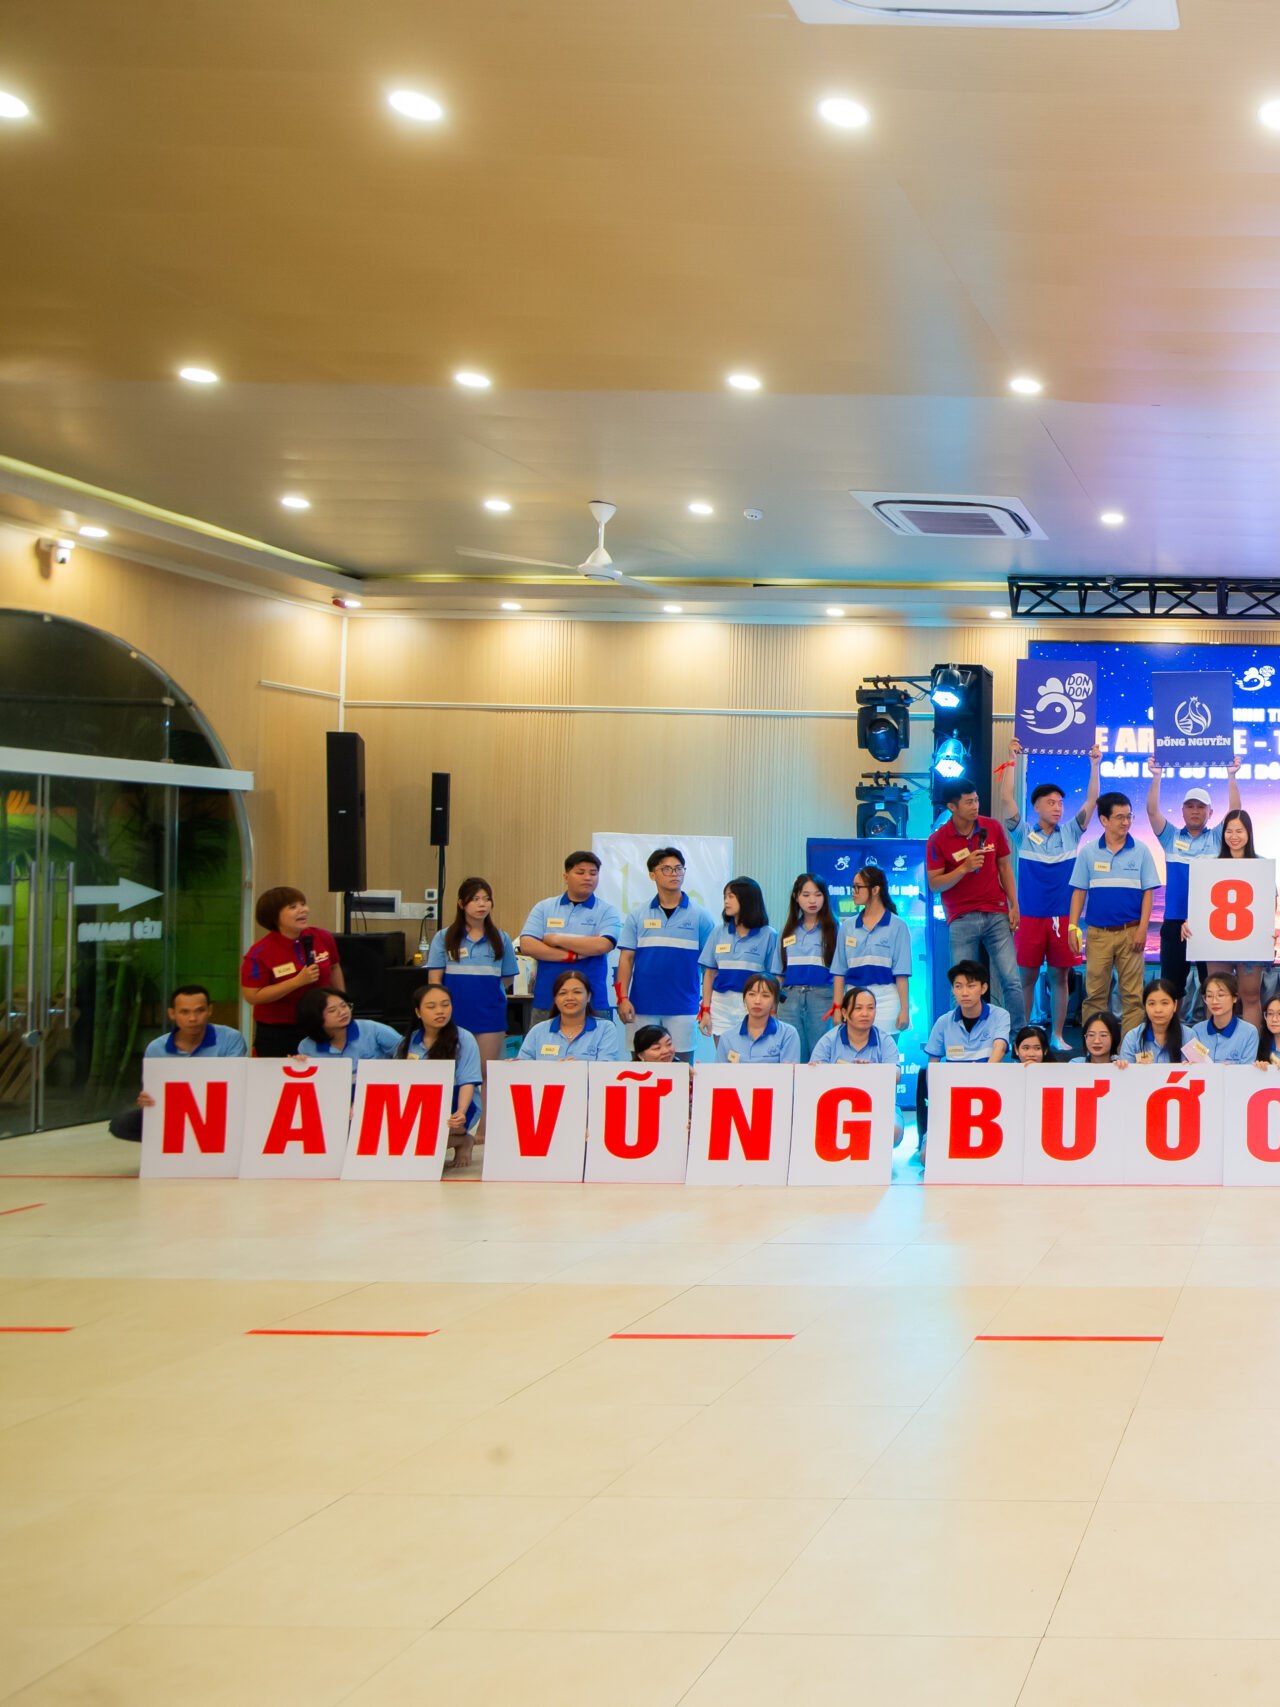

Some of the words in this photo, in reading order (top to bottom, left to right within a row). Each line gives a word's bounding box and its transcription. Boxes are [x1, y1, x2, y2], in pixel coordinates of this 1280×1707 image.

[1067, 675, 1089, 686] DON
[1067, 686, 1090, 697] DON
[162, 1065, 443, 1156] NĂM
[509, 1070, 873, 1162] VỮNG
